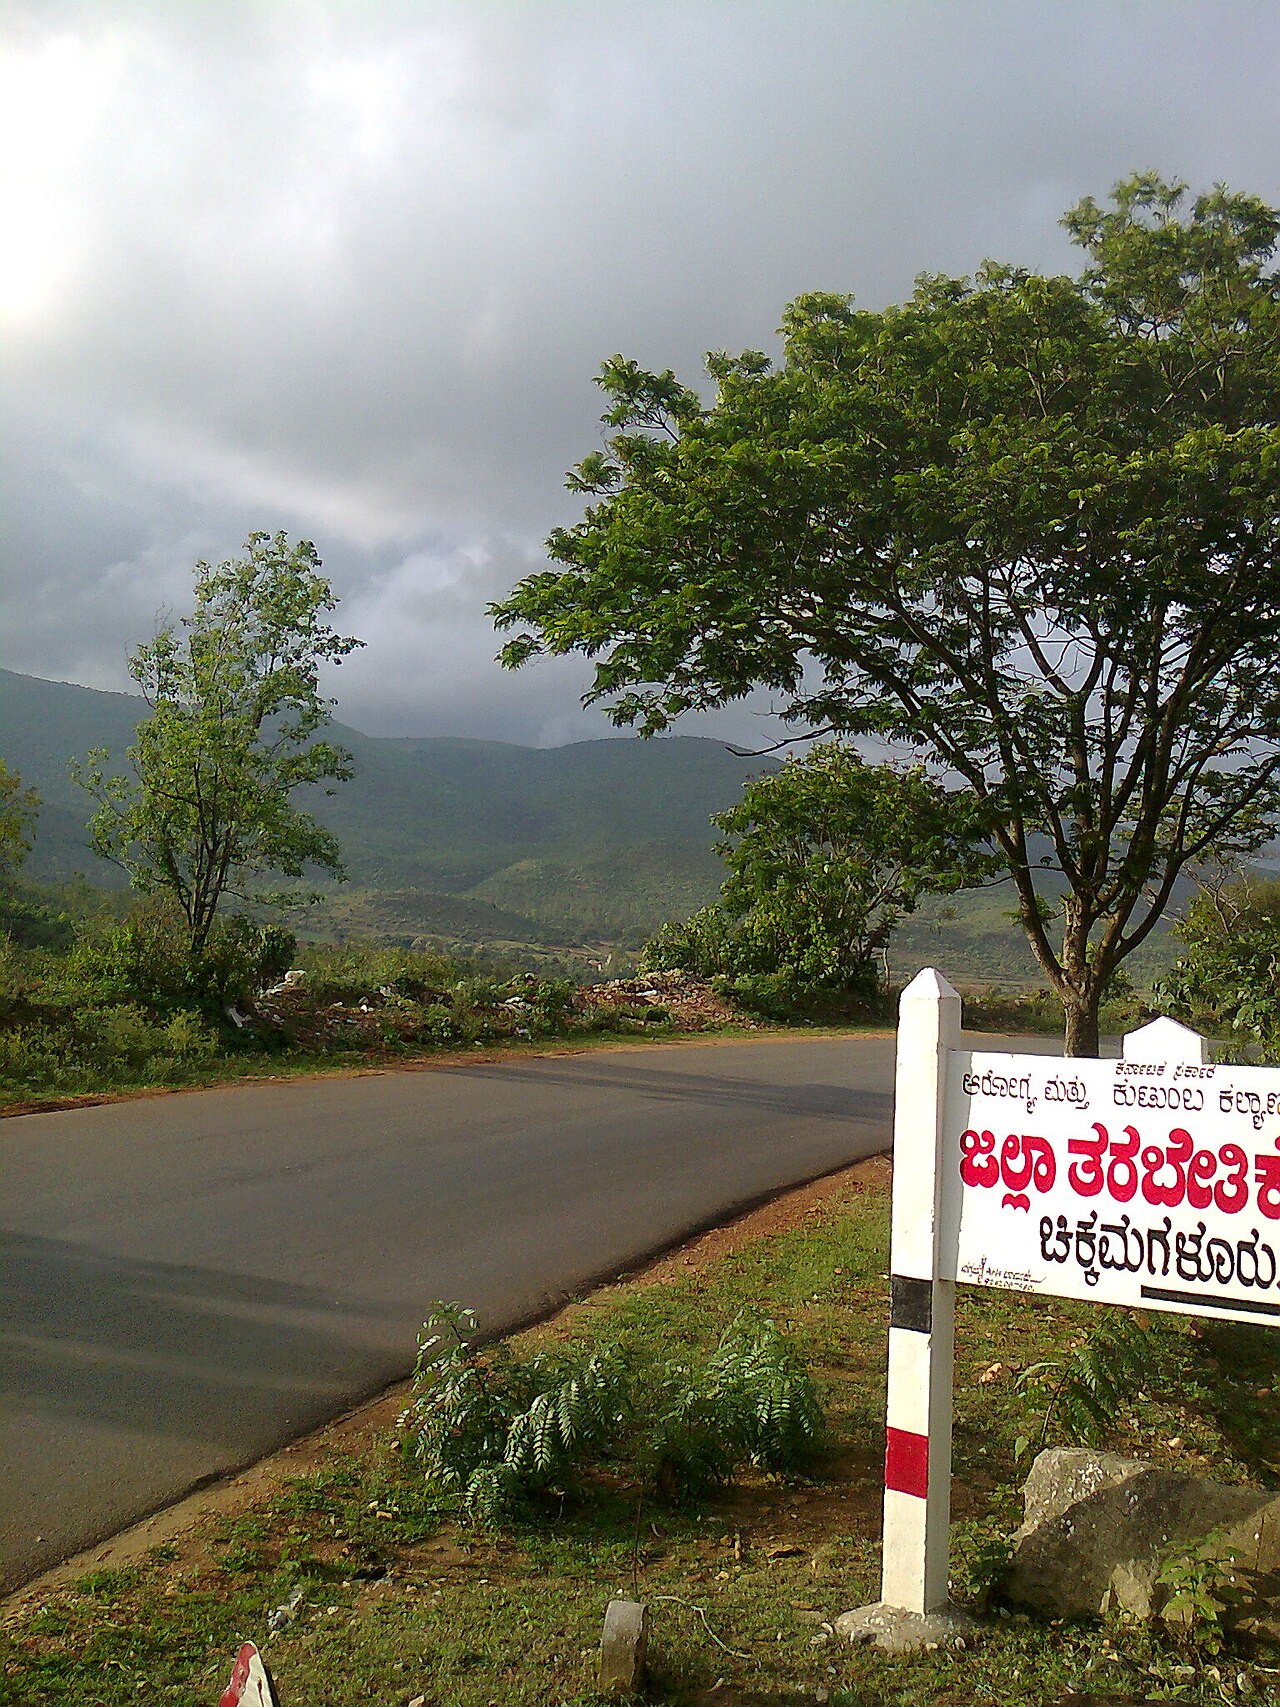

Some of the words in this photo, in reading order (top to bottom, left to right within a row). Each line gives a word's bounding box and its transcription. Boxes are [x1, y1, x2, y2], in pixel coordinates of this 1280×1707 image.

[962, 1069, 1037, 1114] ಆರೋಗ್ಯ
[1044, 1074, 1090, 1110] ಮತ್ತು
[1113, 1078, 1204, 1112] ಕುಟುಂಬ
[1115, 1060, 1167, 1076] ಕರ್ನಾಟಕ
[959, 1129, 1056, 1214] ಜಿಲ್ಲಾ
[1067, 1122, 1249, 1214] ತರಬೇತಿ
[1039, 1210, 1277, 1290] ಚಿಕ್ಕಮಗಳೂರು
